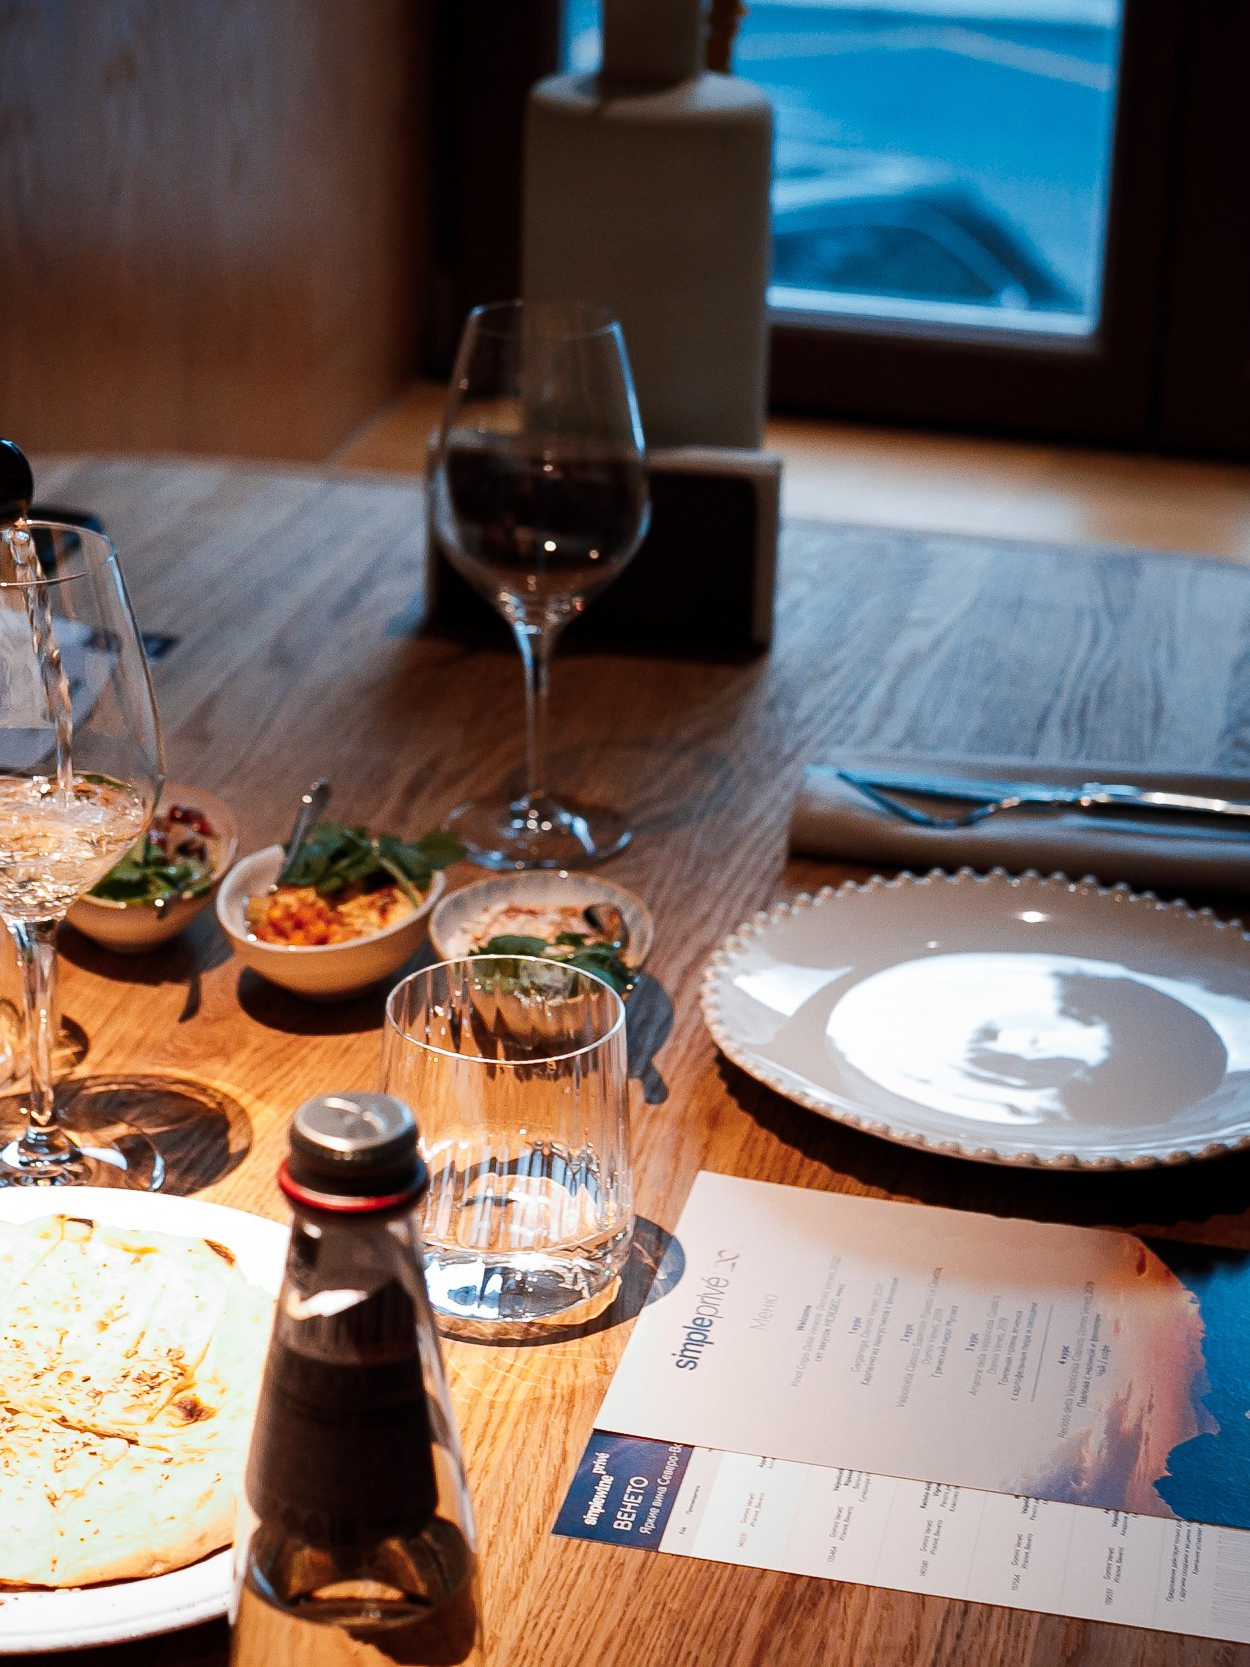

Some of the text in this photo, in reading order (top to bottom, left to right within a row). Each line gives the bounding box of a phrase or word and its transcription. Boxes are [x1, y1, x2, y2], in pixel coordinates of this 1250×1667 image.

[671, 1276, 730, 1371] simpleprivé
[749, 1293, 779, 1331] Меню
[796, 1304, 811, 1331] Welcome
[852, 1316, 862, 1330] курс
[903, 1323, 914, 1337] курс
[969, 1332, 978, 1347] курс
[931, 1345, 948, 1378] Греческий
[1060, 1345, 1071, 1360] курс
[1057, 1413, 1069, 1438] Recioto
[592, 1452, 610, 1475] privé
[583, 1475, 615, 1526] simplewine
[613, 1476, 649, 1531] ВЕНЕТО
[639, 1507, 660, 1534] Яркие
[652, 1486, 668, 1508] вина
